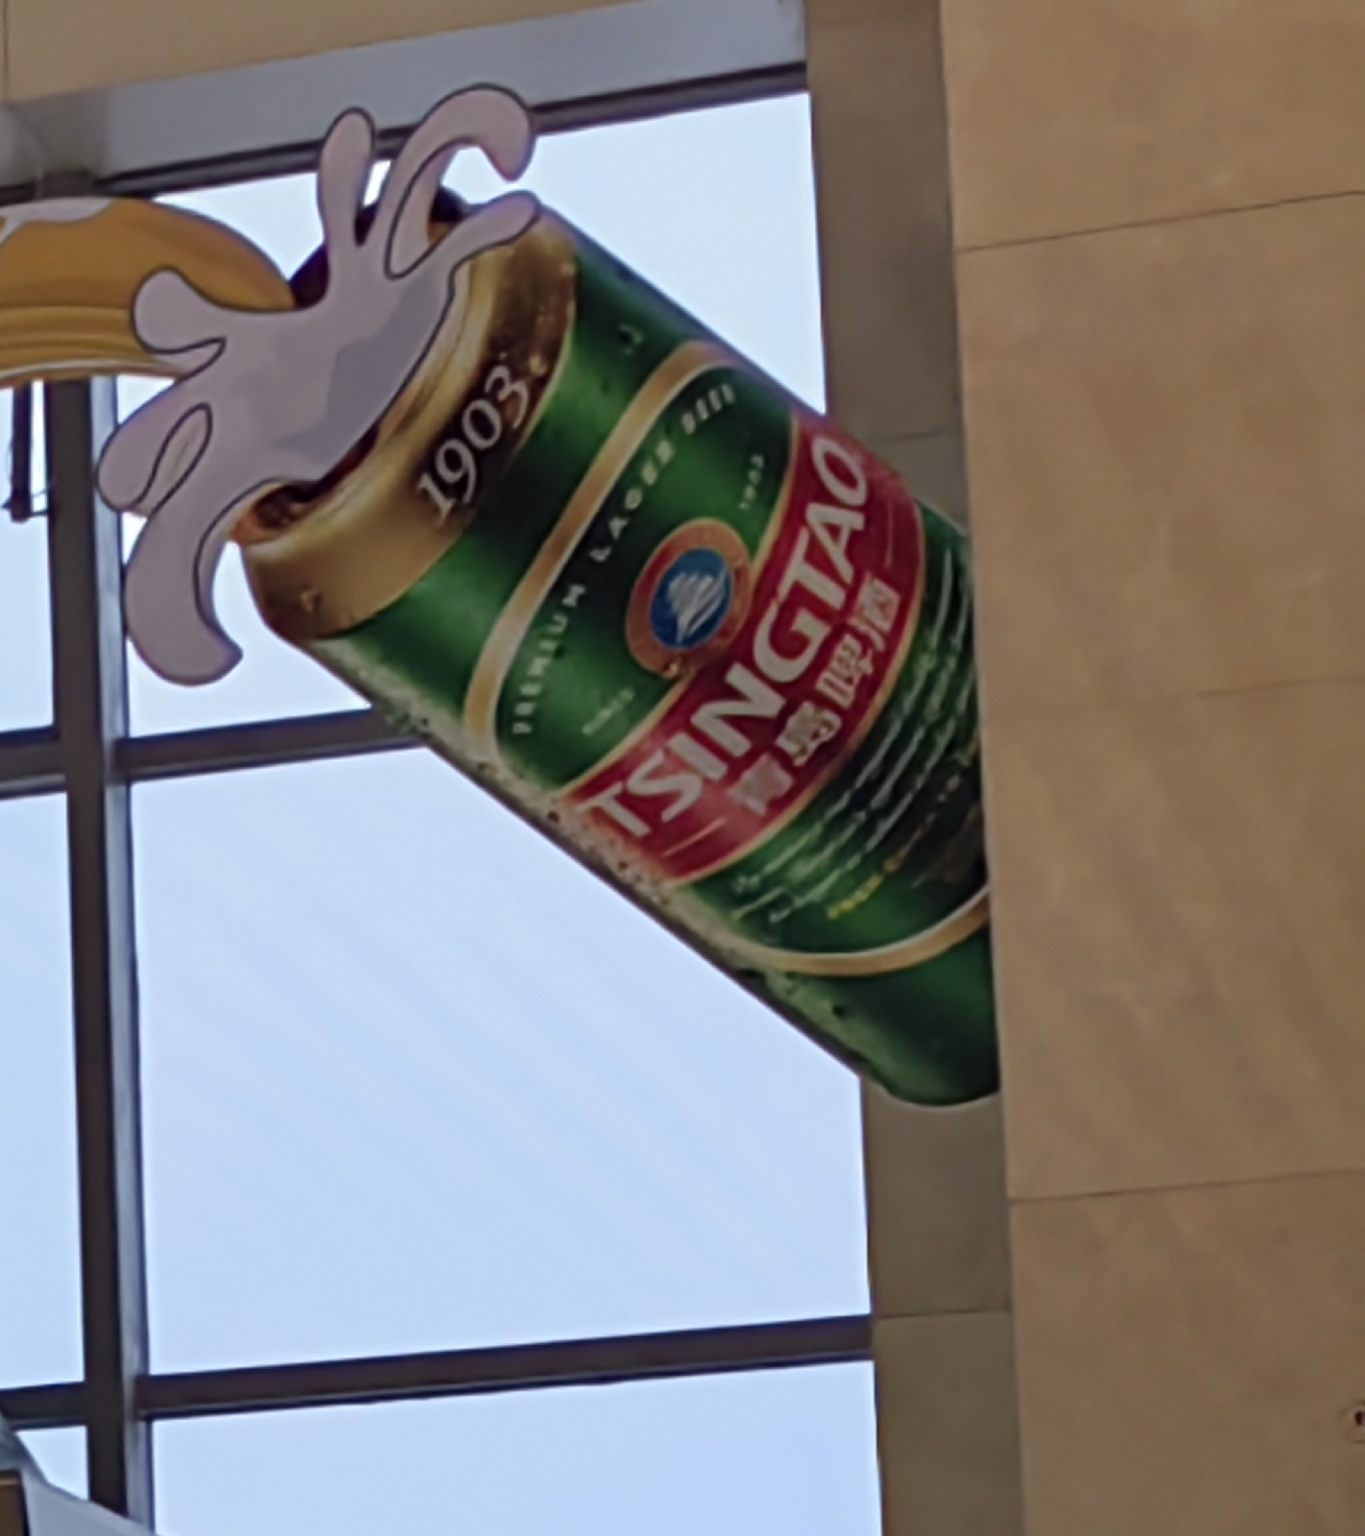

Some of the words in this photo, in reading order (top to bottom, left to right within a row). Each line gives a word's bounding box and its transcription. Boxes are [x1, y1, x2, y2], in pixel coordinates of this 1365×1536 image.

[416, 362, 534, 523] 1903
[512, 583, 587, 735] PREMIUM
[588, 438, 676, 563] LAGER
[583, 435, 871, 840] TSINGTAO
